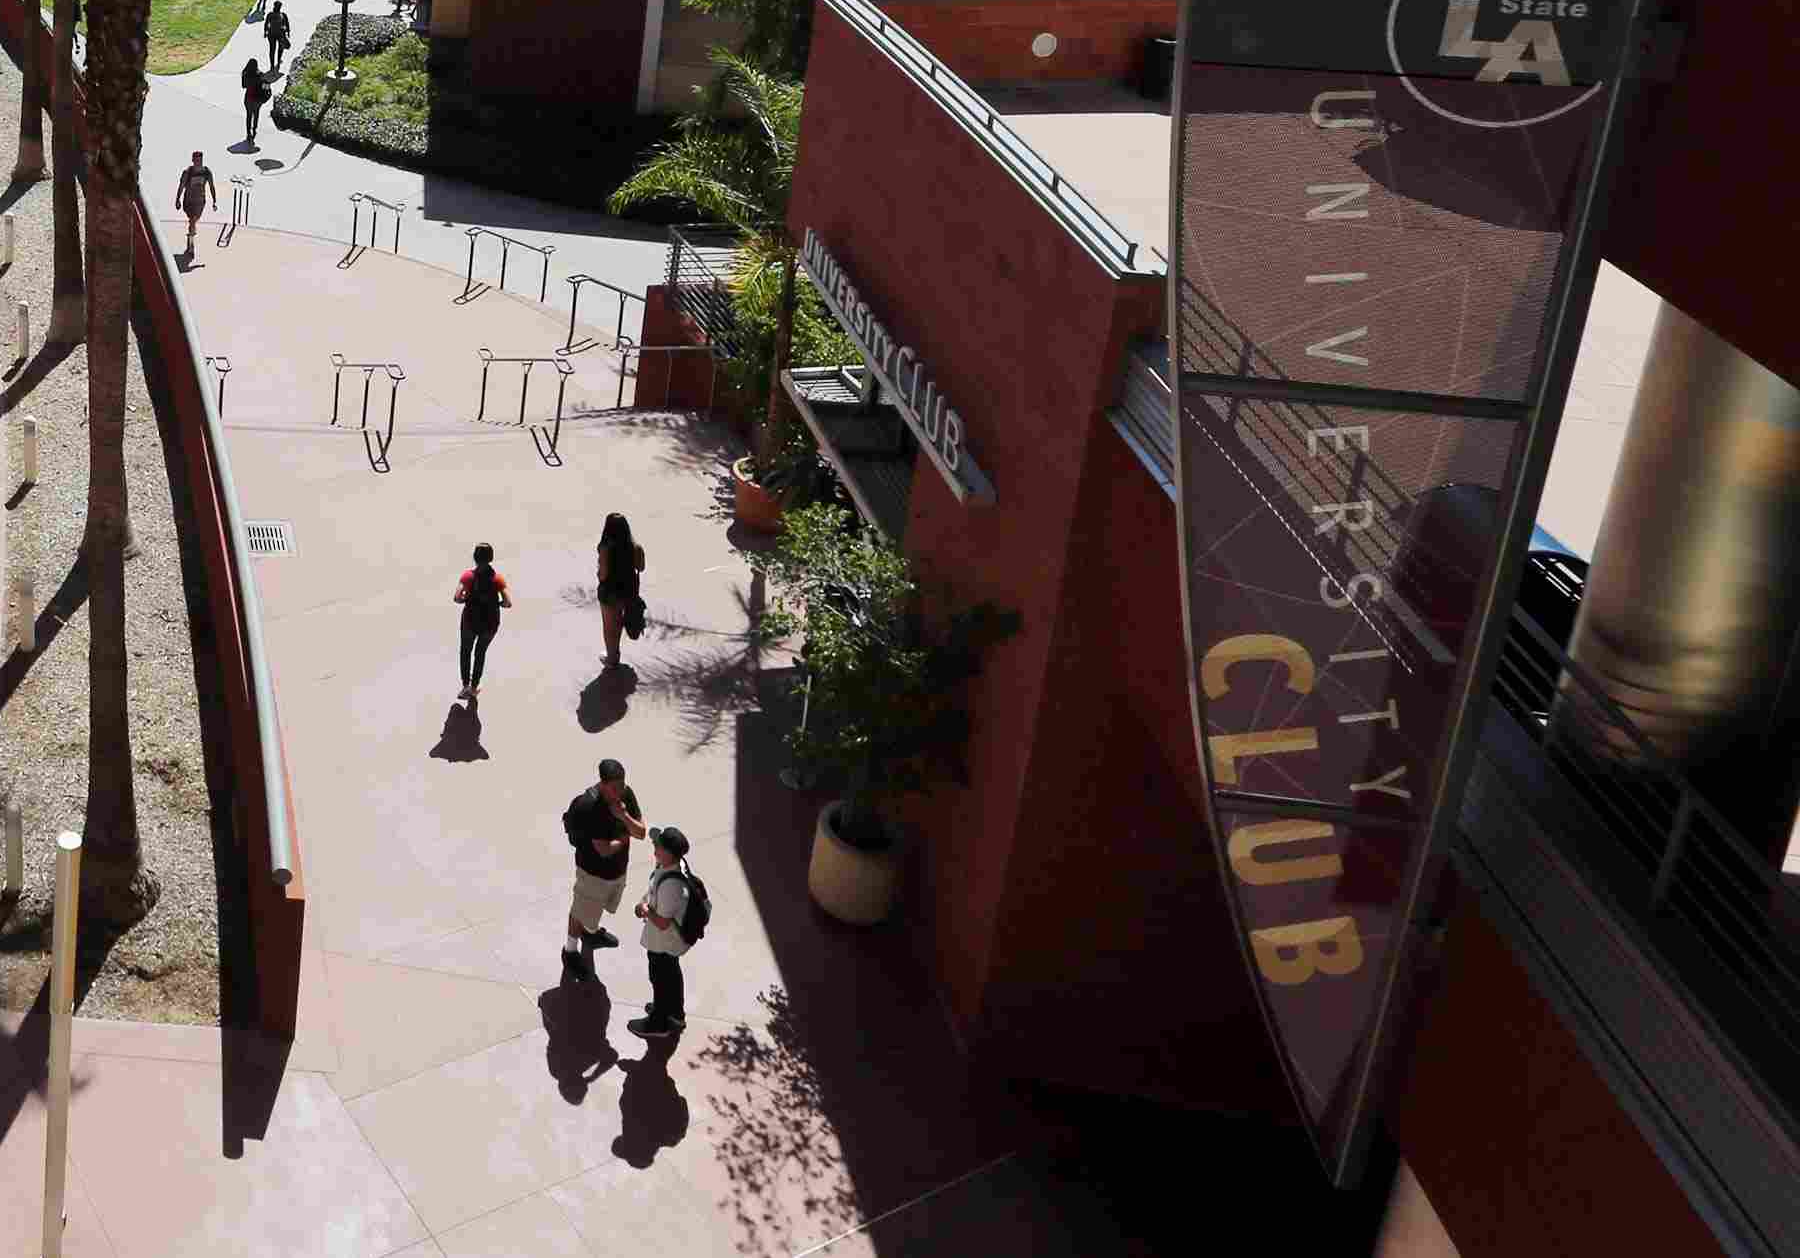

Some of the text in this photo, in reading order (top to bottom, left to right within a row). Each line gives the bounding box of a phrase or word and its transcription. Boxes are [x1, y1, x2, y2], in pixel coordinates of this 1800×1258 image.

[803, 226, 960, 471] UNIVERSITY CLUB
[1304, 89, 1411, 799] UNIVERSITY
[1200, 632, 1364, 987] CLUB
